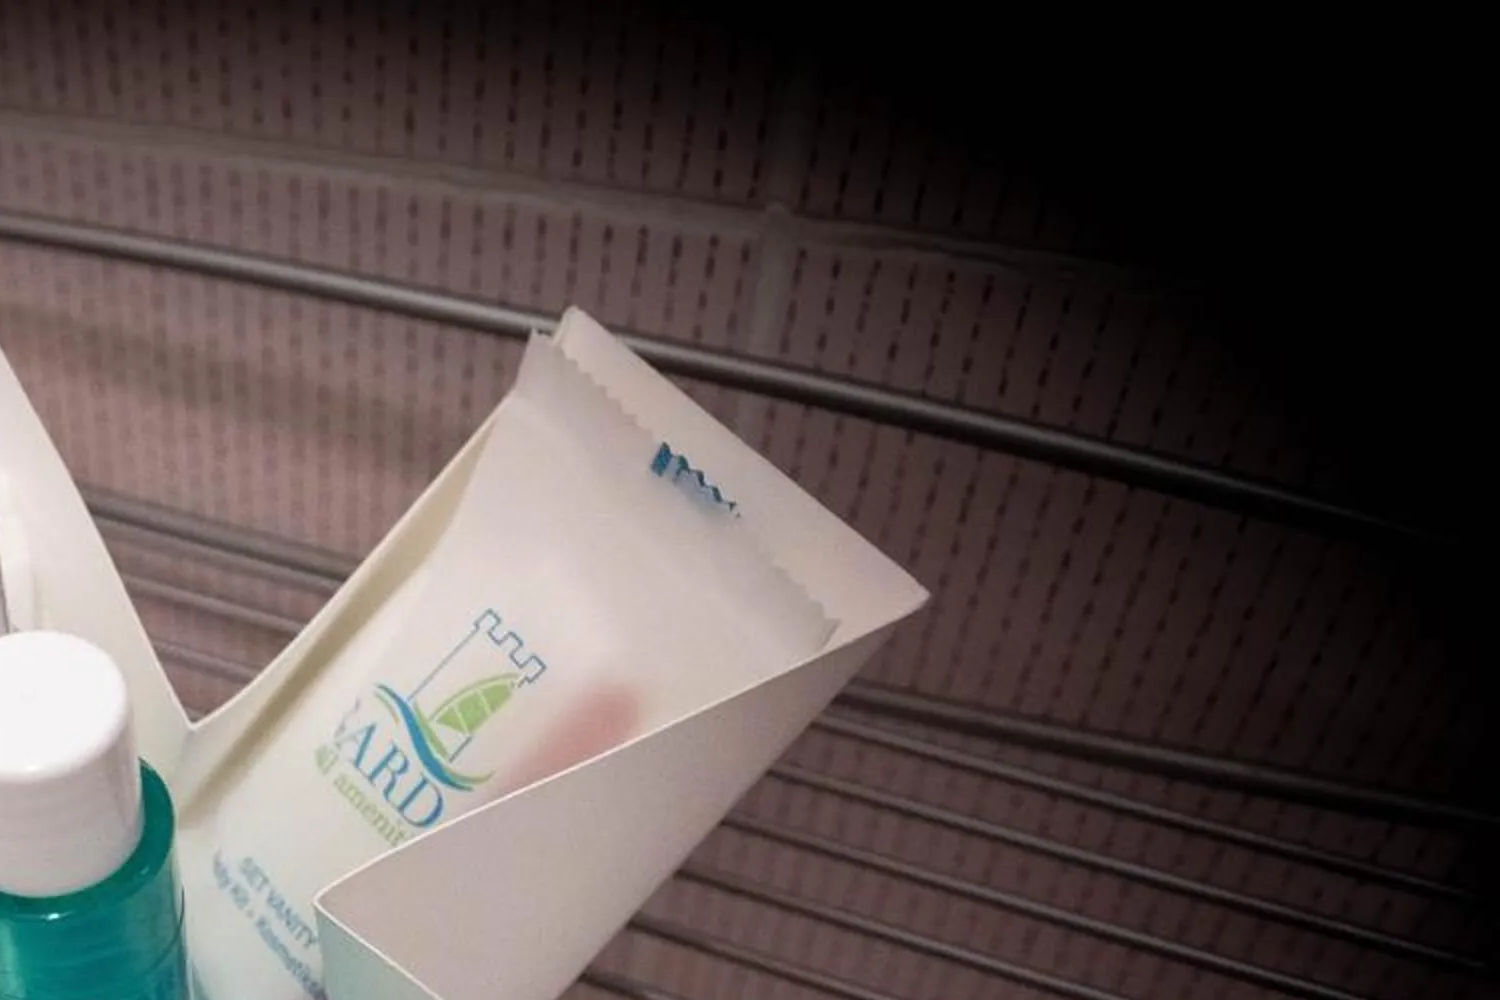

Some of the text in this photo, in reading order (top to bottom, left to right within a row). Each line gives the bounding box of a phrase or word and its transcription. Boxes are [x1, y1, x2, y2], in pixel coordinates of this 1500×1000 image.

[333, 772, 414, 847] amenit
[334, 700, 443, 828] ARD
[240, 856, 318, 949] SET VANITY
